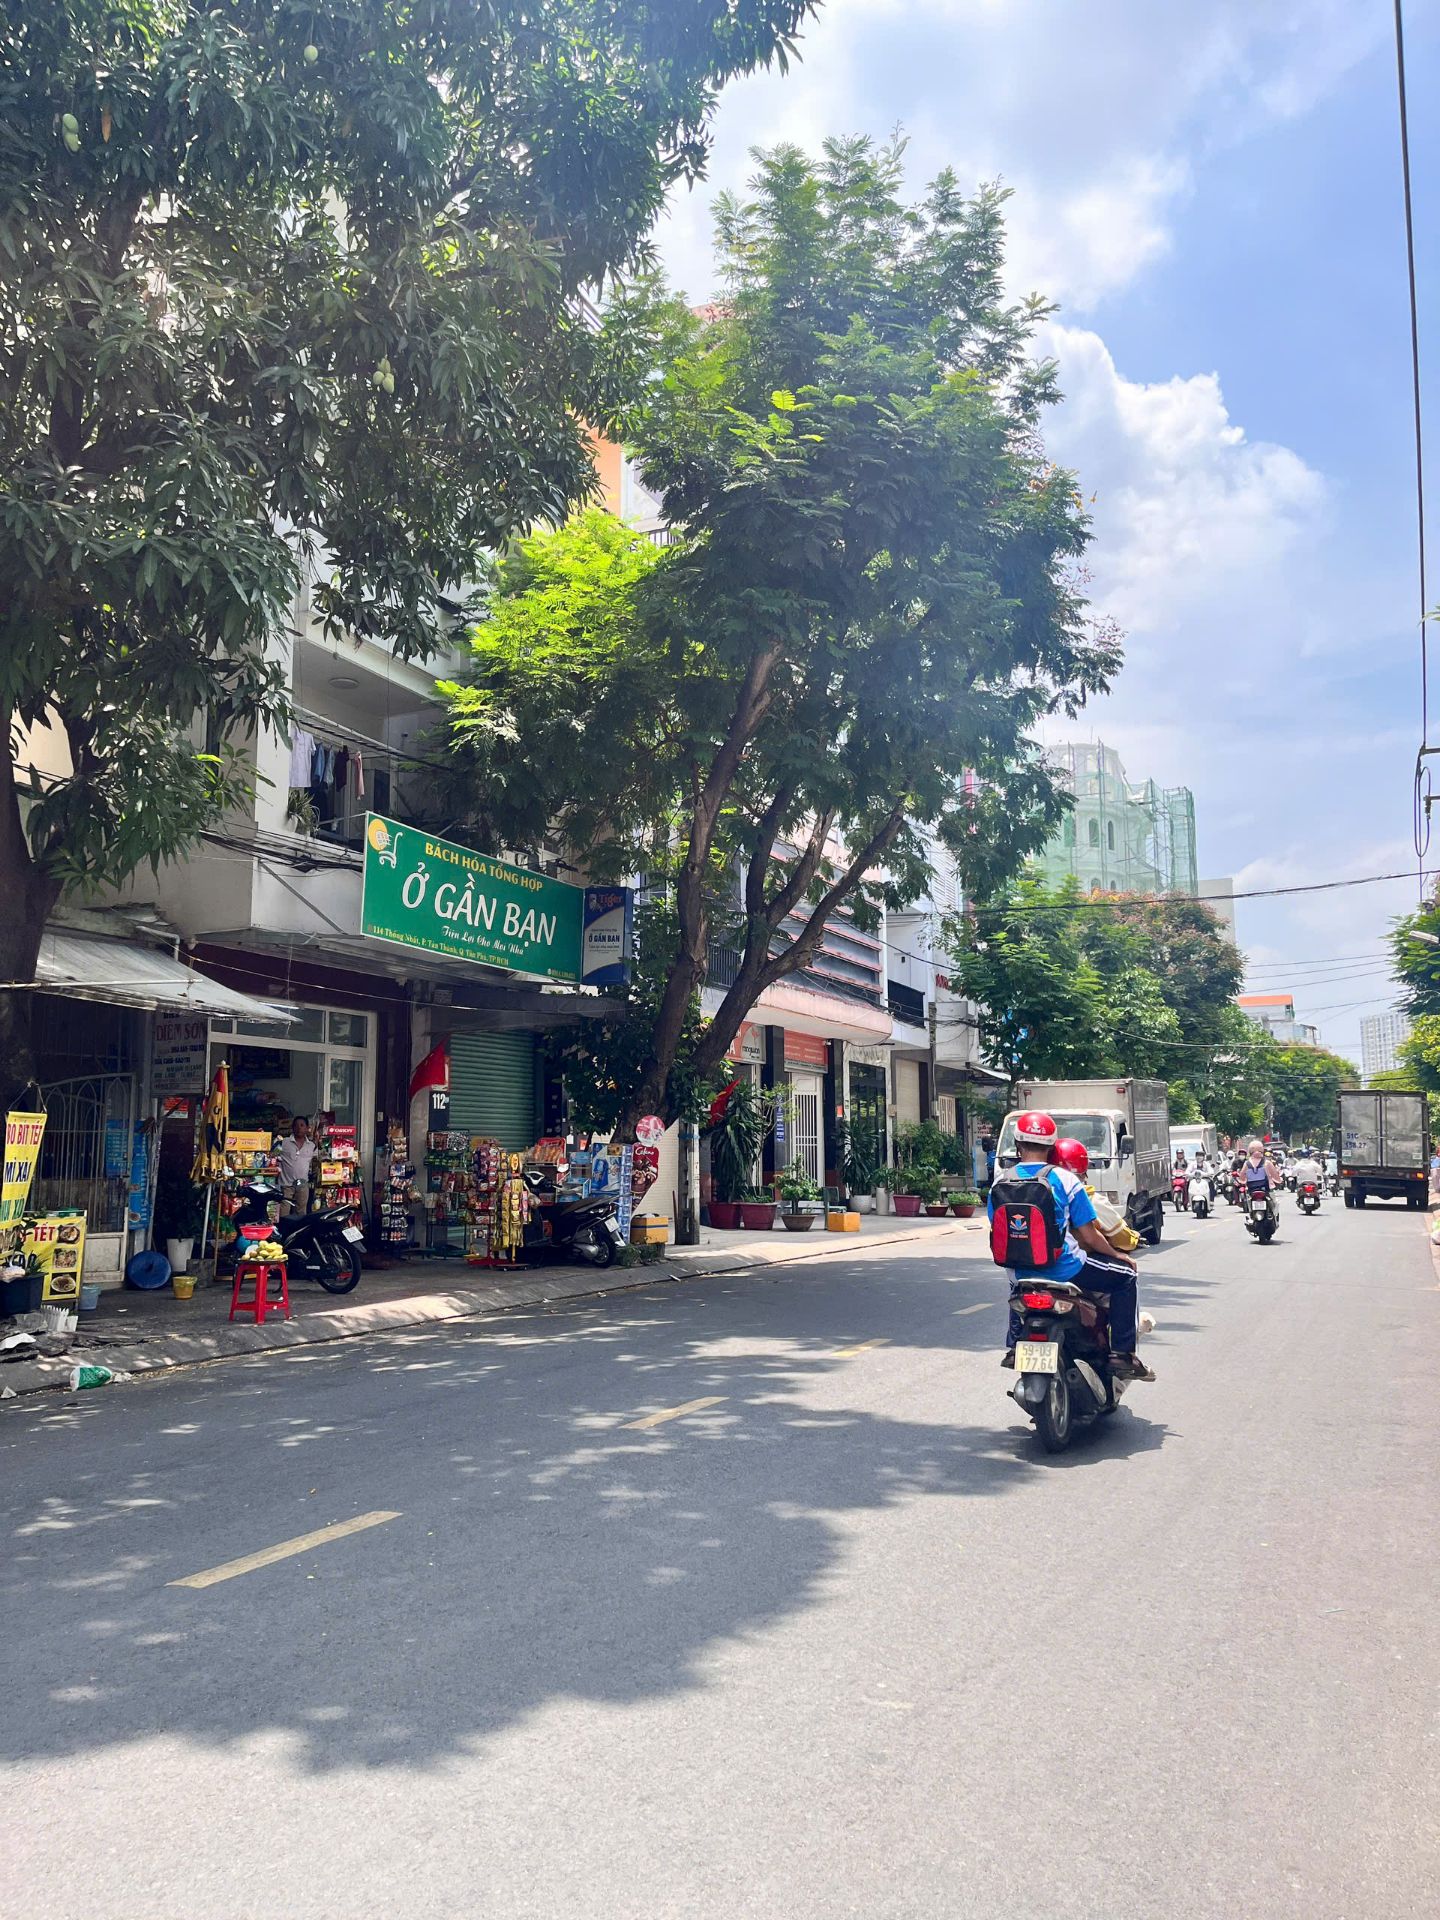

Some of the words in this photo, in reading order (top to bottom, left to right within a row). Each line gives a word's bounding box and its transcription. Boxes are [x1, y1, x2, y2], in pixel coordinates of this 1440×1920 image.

[425, 842, 459, 865] BÁCH
[462, 856, 487, 875] HÓA
[489, 862, 518, 885] TỔNG
[520, 876, 543, 892] HỢP
[402, 861, 430, 909] Ở
[434, 872, 497, 930] GẦN
[503, 902, 557, 948] BẠN
[476, 934, 491, 948] Cho
[432, 1093, 446, 1109] 112
[33, 1222, 56, 1242] TẾT
